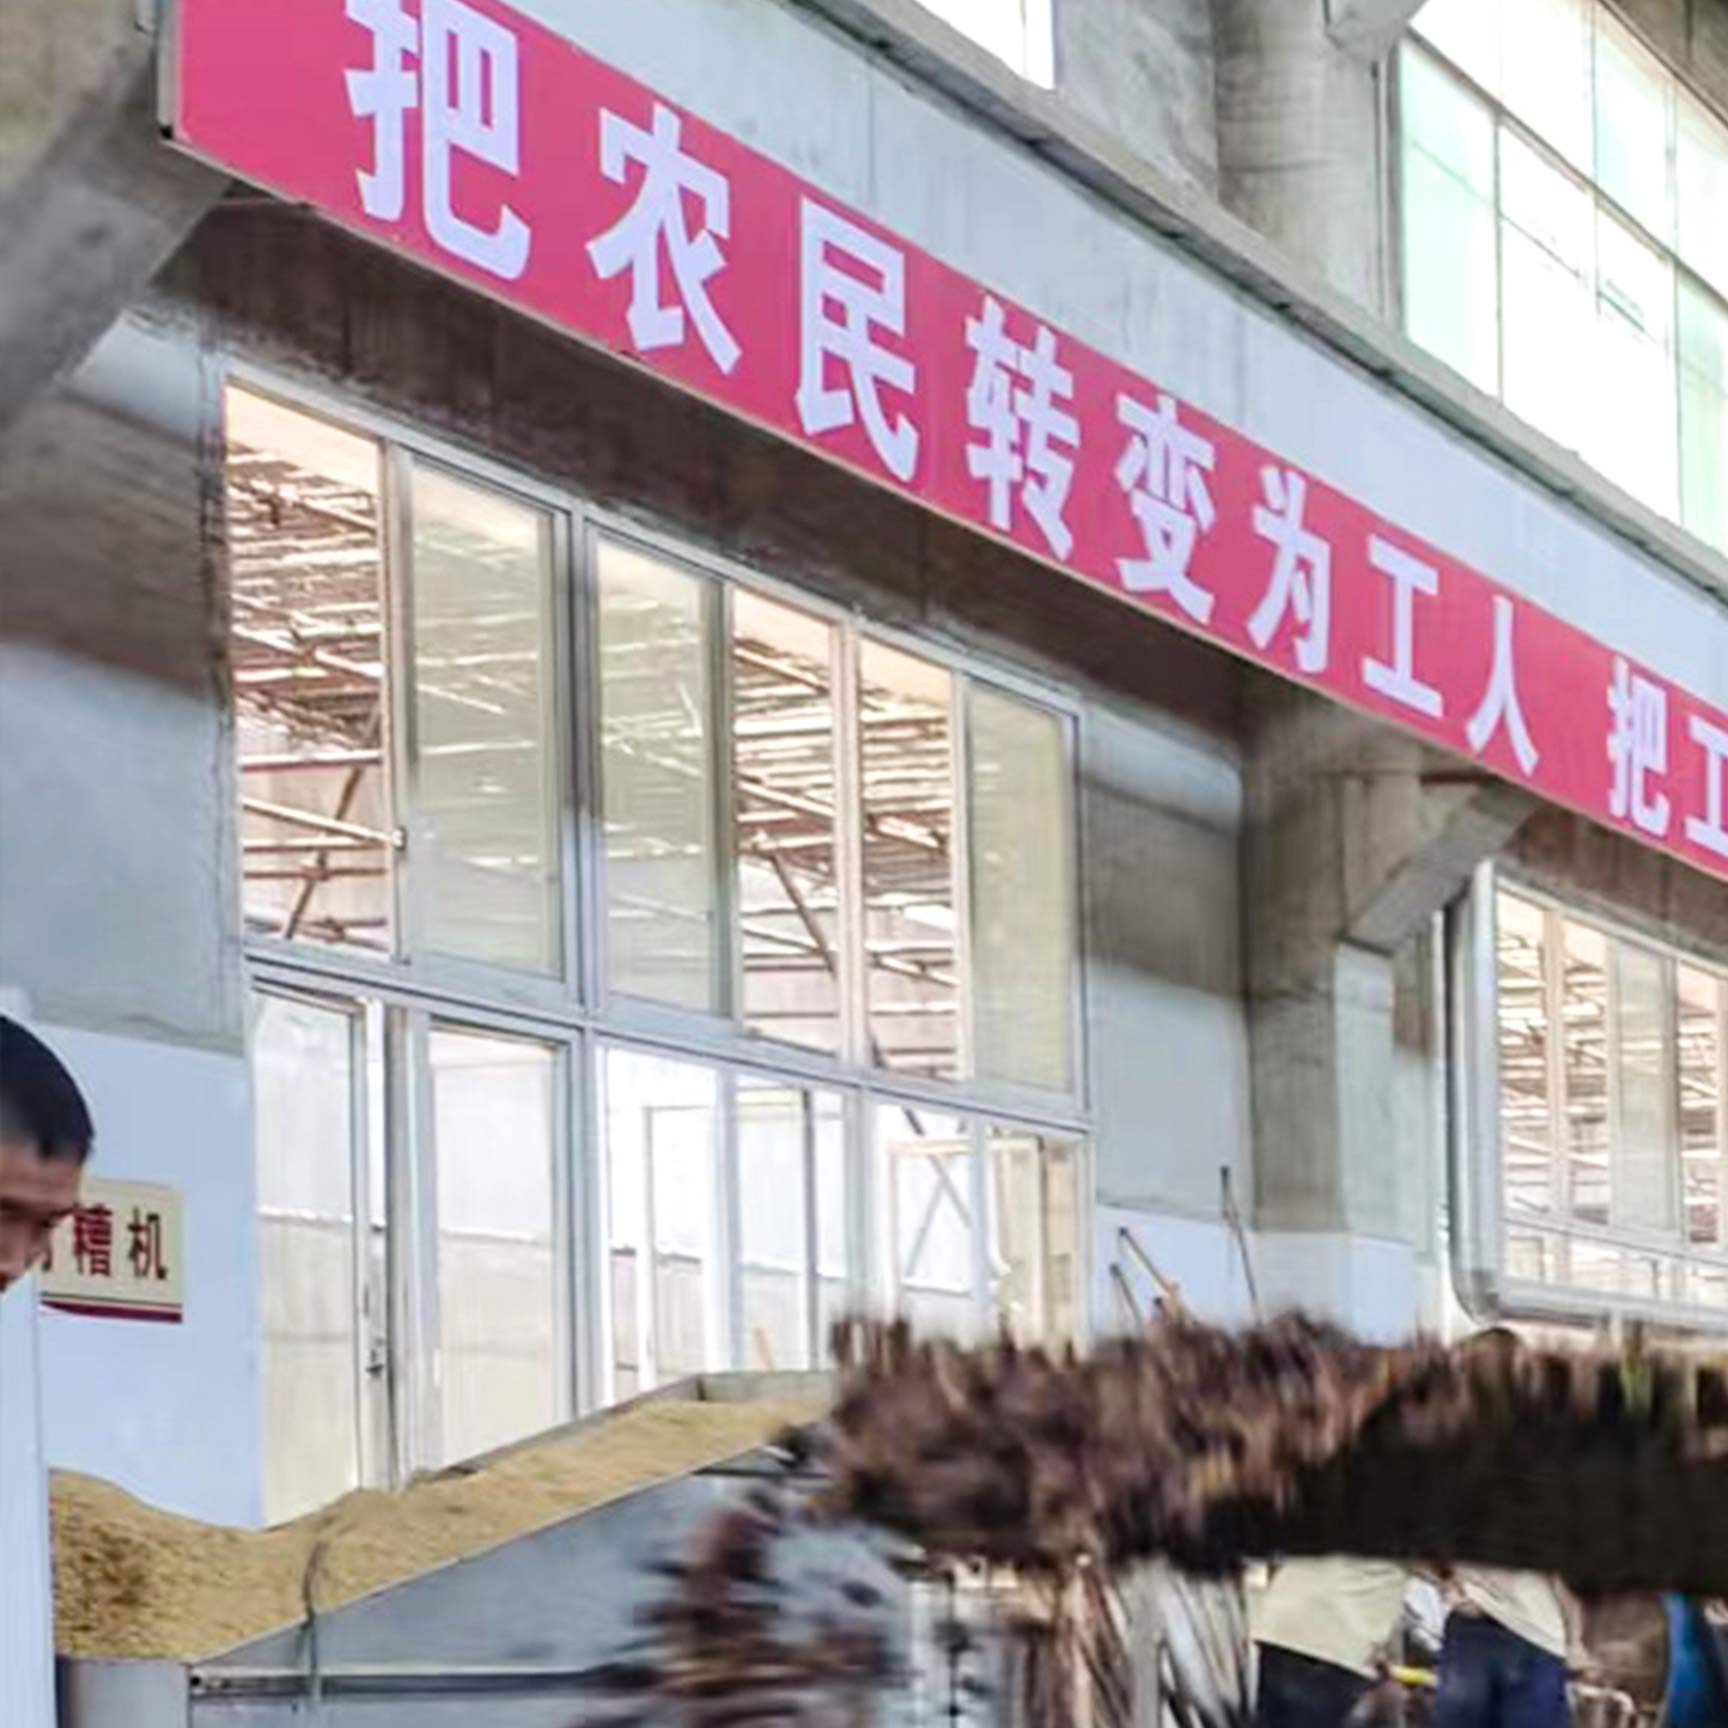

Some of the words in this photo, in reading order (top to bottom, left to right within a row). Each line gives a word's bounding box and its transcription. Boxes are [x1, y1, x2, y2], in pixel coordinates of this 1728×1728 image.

[345, 0, 1540, 774] 把农民转变为工人
[41, 1205, 167, 1280] 糟机
